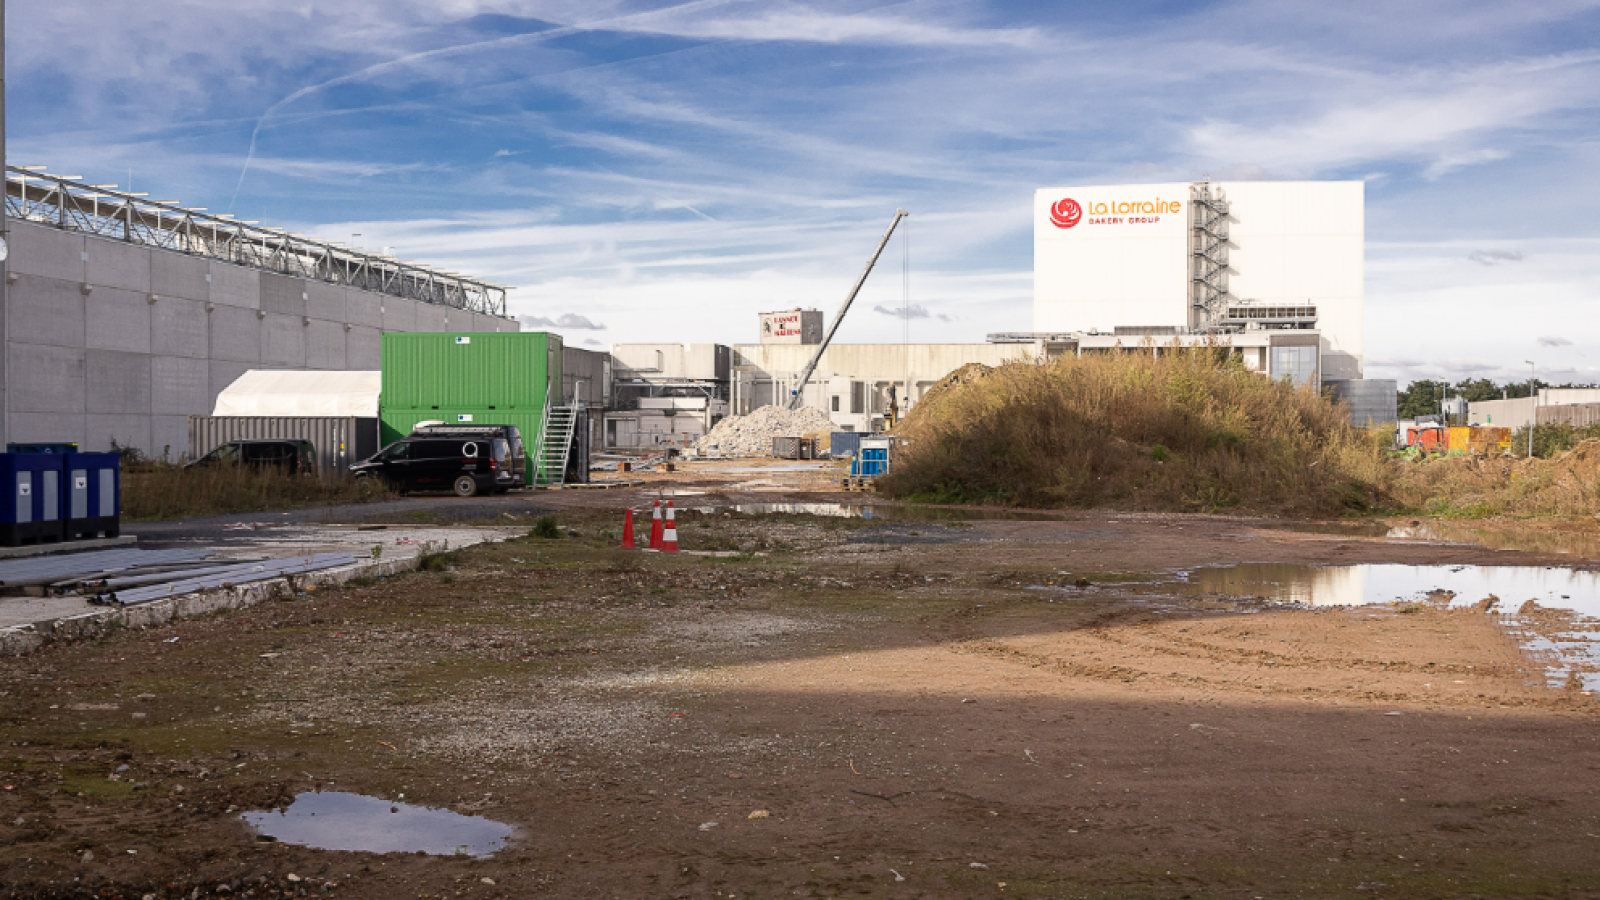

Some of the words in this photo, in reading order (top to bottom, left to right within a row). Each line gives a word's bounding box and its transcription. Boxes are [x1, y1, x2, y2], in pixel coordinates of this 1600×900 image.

[1088, 201, 1108, 215] La
[1111, 197, 1181, 215] Lorraine
[1088, 217, 1124, 225] BAKERY
[1128, 216, 1160, 224] GROUP
